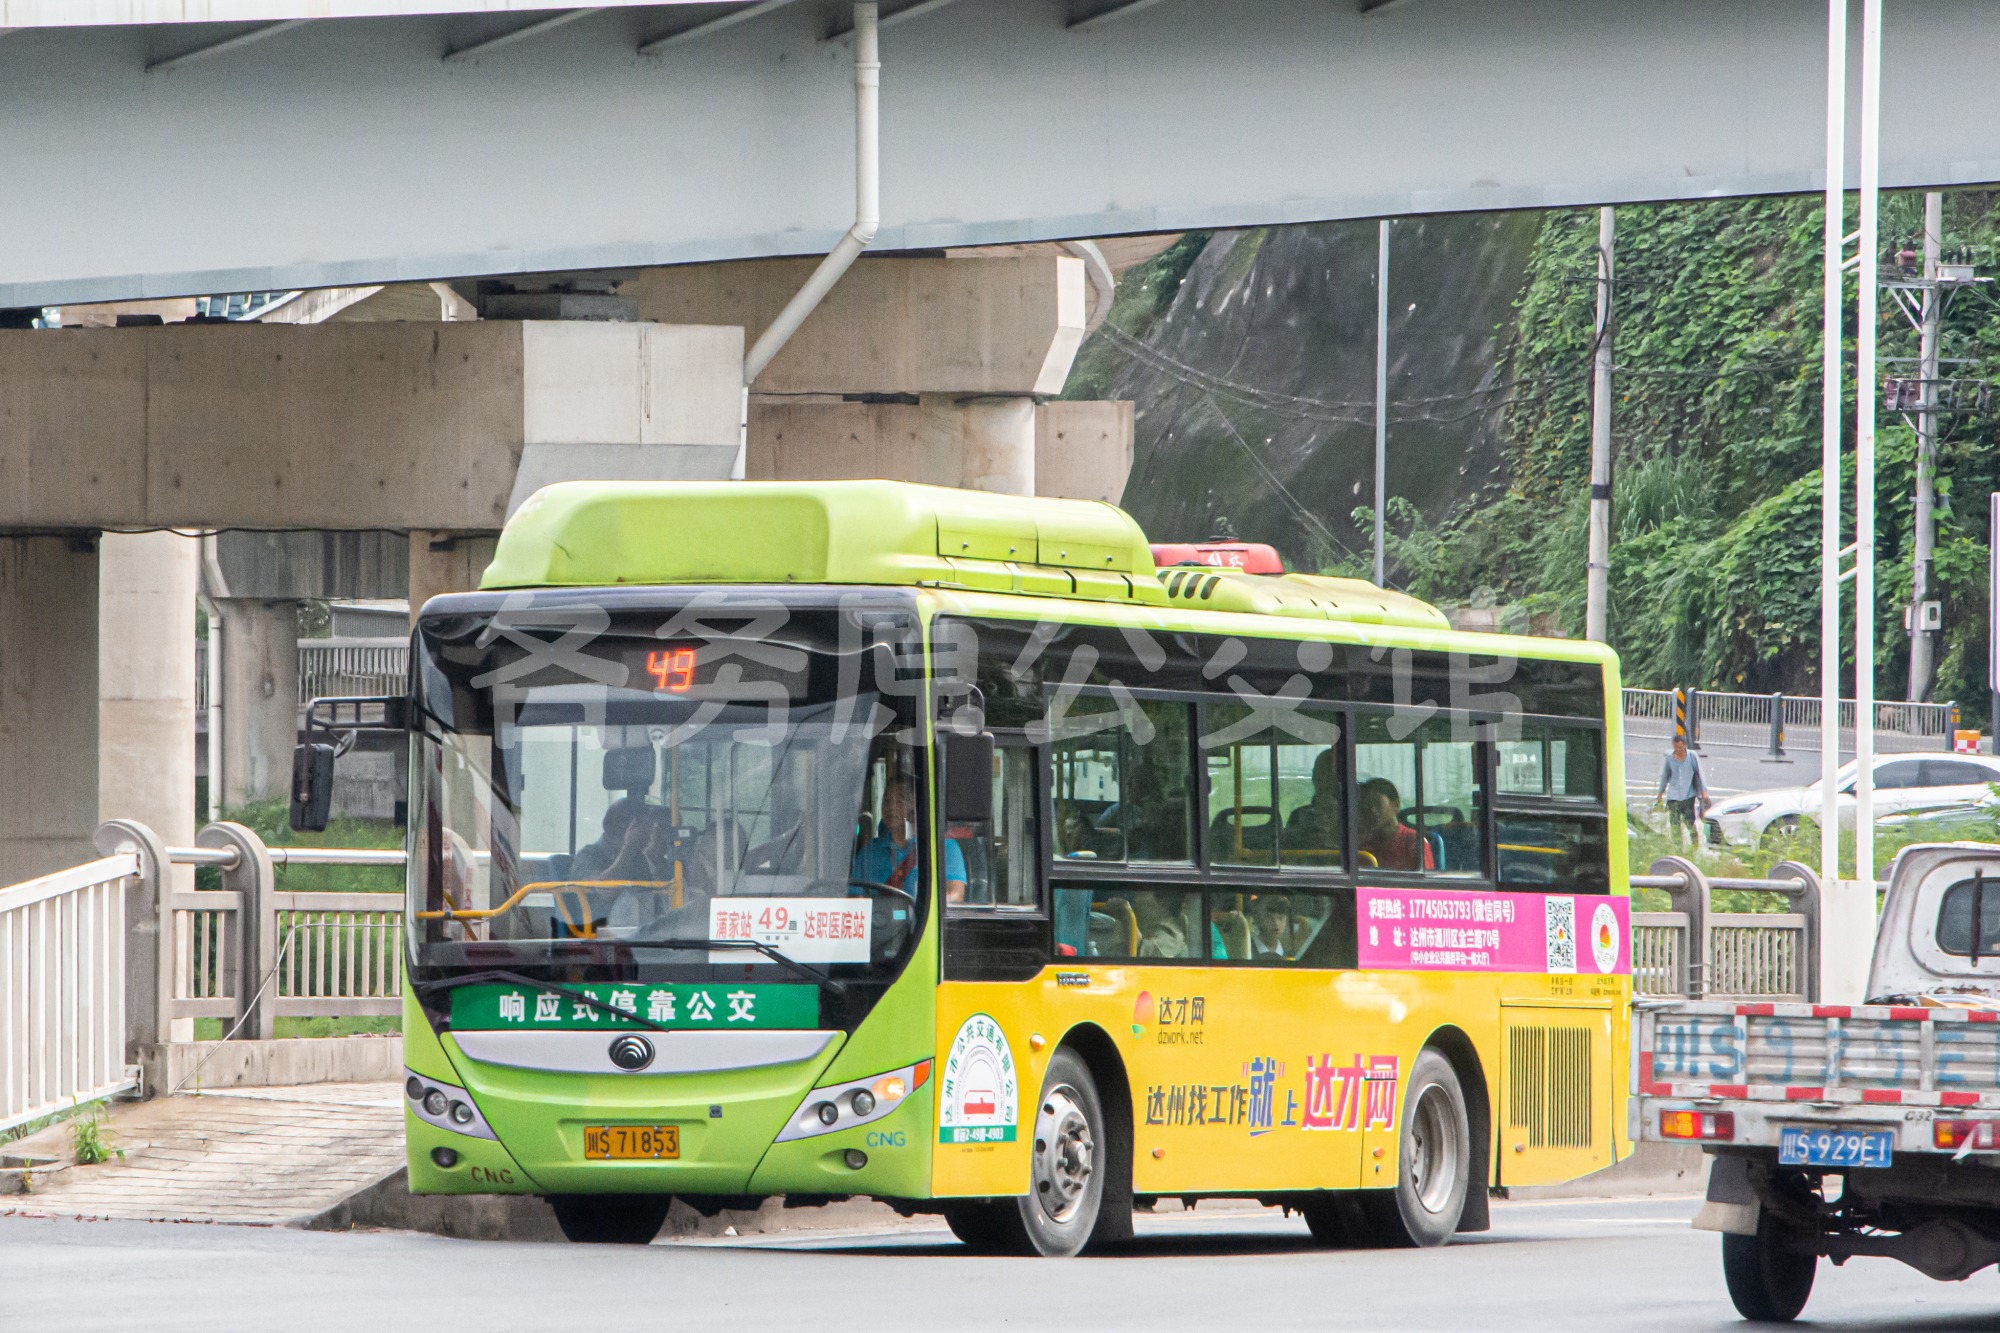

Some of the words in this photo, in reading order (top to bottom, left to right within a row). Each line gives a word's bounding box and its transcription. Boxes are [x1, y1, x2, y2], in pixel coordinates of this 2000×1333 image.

[646, 648, 695, 693] 49
[803, 911, 866, 940] 达职医院站
[499, 990, 756, 1022] 响应式停靠公交
[1159, 996, 1205, 1025] 达才网
[1157, 1027, 1203, 1045] dzwork.net
[944, 1019, 1014, 1124] 达州市公共交通有限公司
[866, 1131, 907, 1148] CNG
[470, 1166, 515, 1185] CNG
